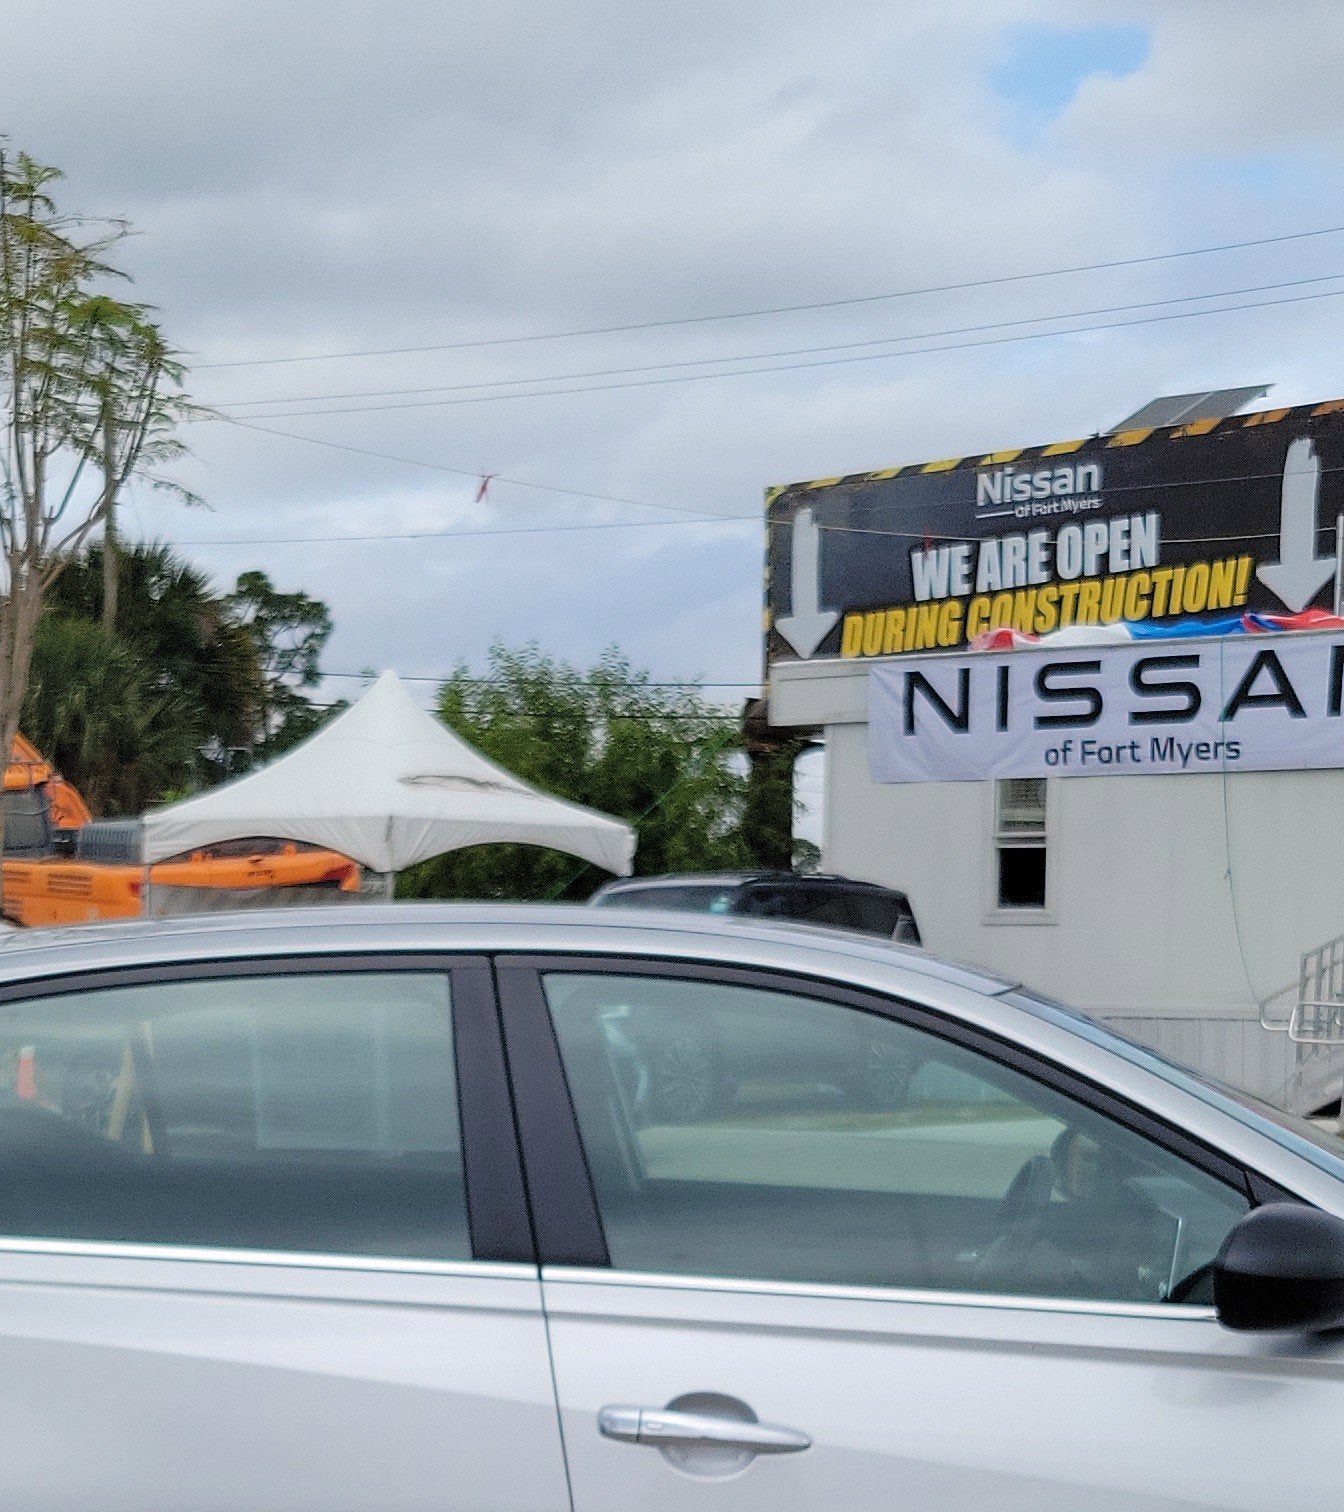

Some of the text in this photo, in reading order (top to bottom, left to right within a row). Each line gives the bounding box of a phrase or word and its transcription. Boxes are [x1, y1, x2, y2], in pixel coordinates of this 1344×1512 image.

[977, 464, 1099, 507] Nissan
[1016, 498, 1103, 518] of Fort Myers
[911, 512, 1160, 601] WE ARE OPEN
[841, 554, 1254, 657] DURING CONSTRUCTION!
[1044, 736, 1242, 769] of Fort Myers
